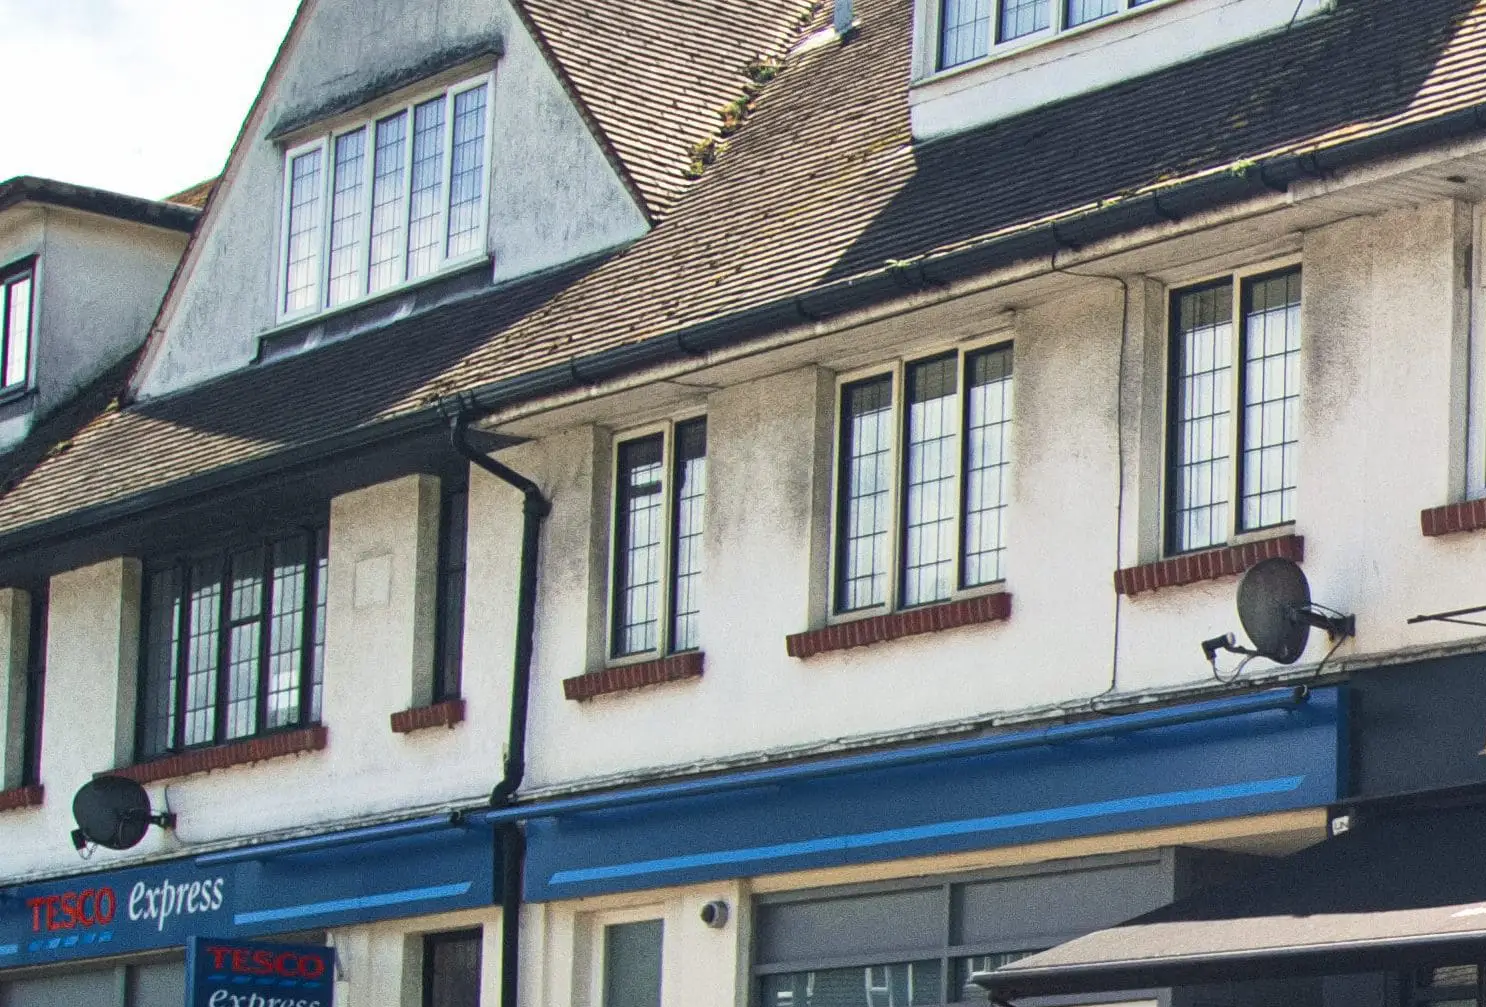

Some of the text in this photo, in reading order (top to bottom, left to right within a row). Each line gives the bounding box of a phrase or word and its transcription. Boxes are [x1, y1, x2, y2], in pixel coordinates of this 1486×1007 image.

[27, 877, 224, 932] TESCO express
[208, 946, 324, 979] TESCO
